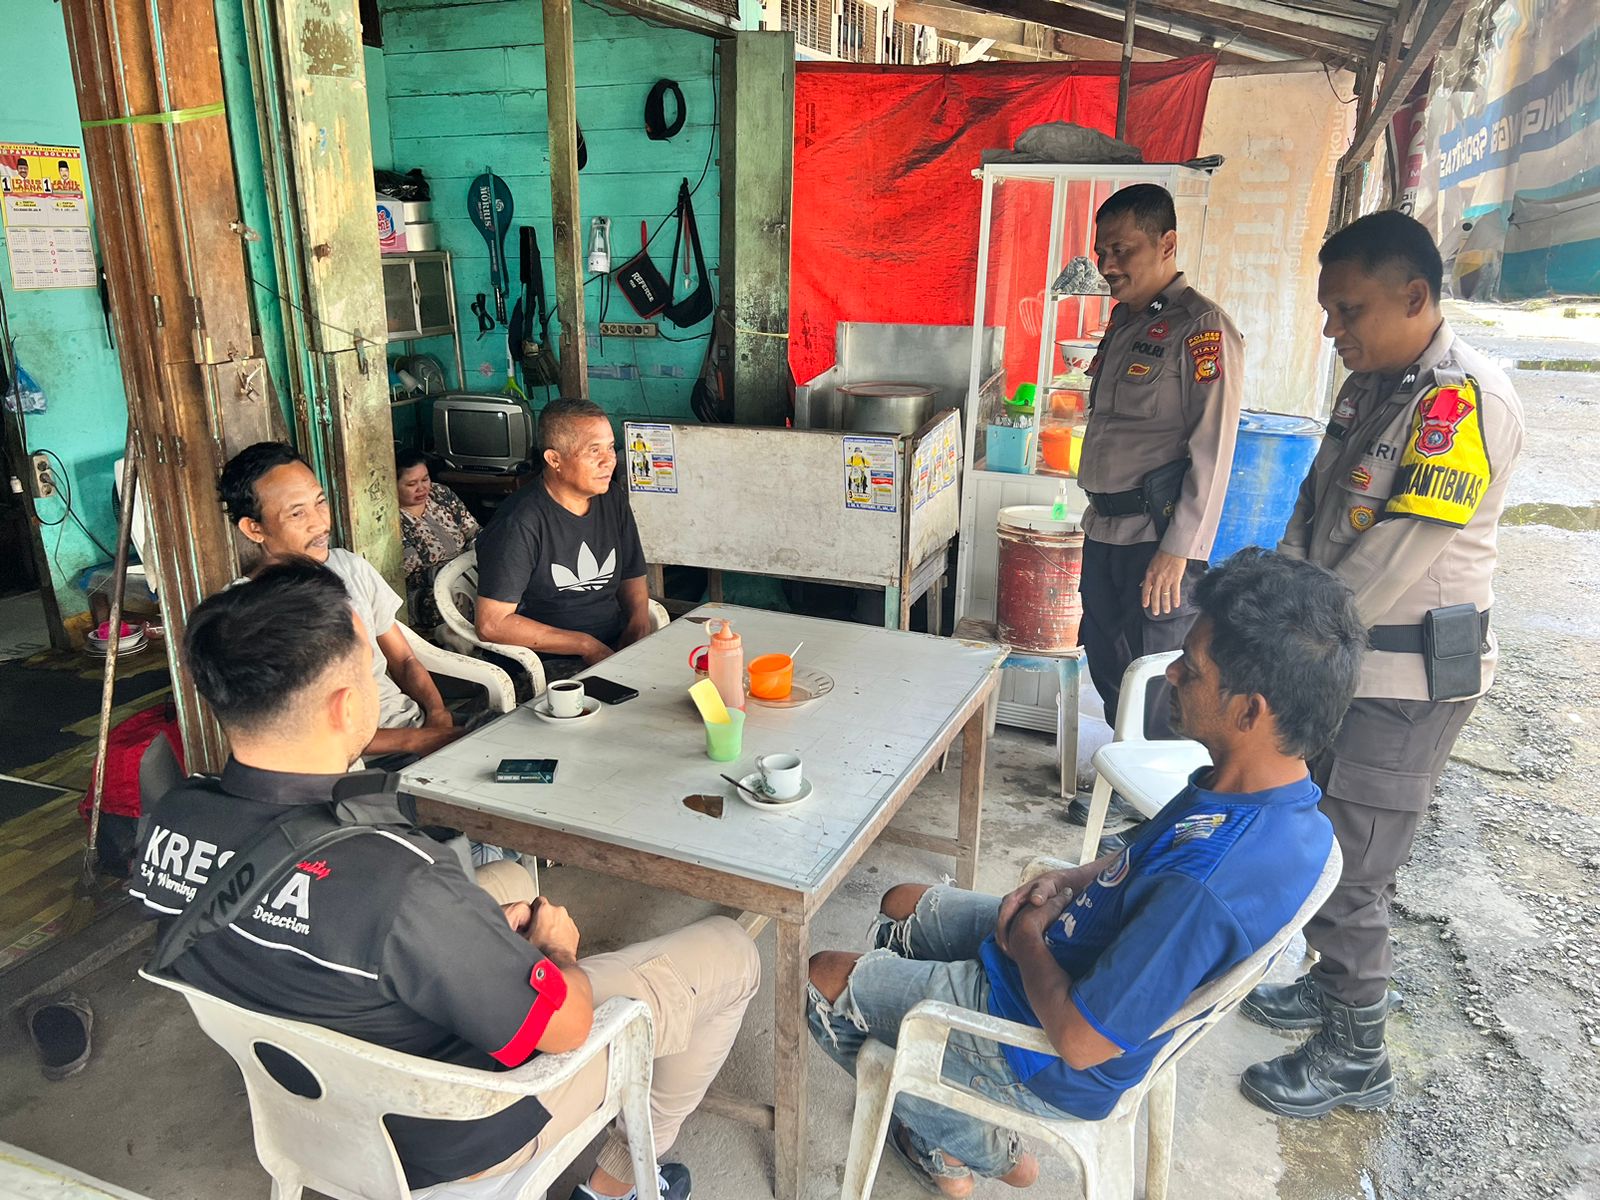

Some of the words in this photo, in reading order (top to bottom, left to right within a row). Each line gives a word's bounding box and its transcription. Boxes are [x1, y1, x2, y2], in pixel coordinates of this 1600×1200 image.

[2, 177, 11, 191] 1
[44, 178, 51, 192] 1
[480, 186, 492, 227] MORRIS
[631, 271, 655, 303] REFEREE
[1188, 332, 1220, 344] POLRES
[1131, 341, 1165, 358] POLRI
[1193, 346, 1218, 356] RIAU
[252, 904, 310, 936] Detection
